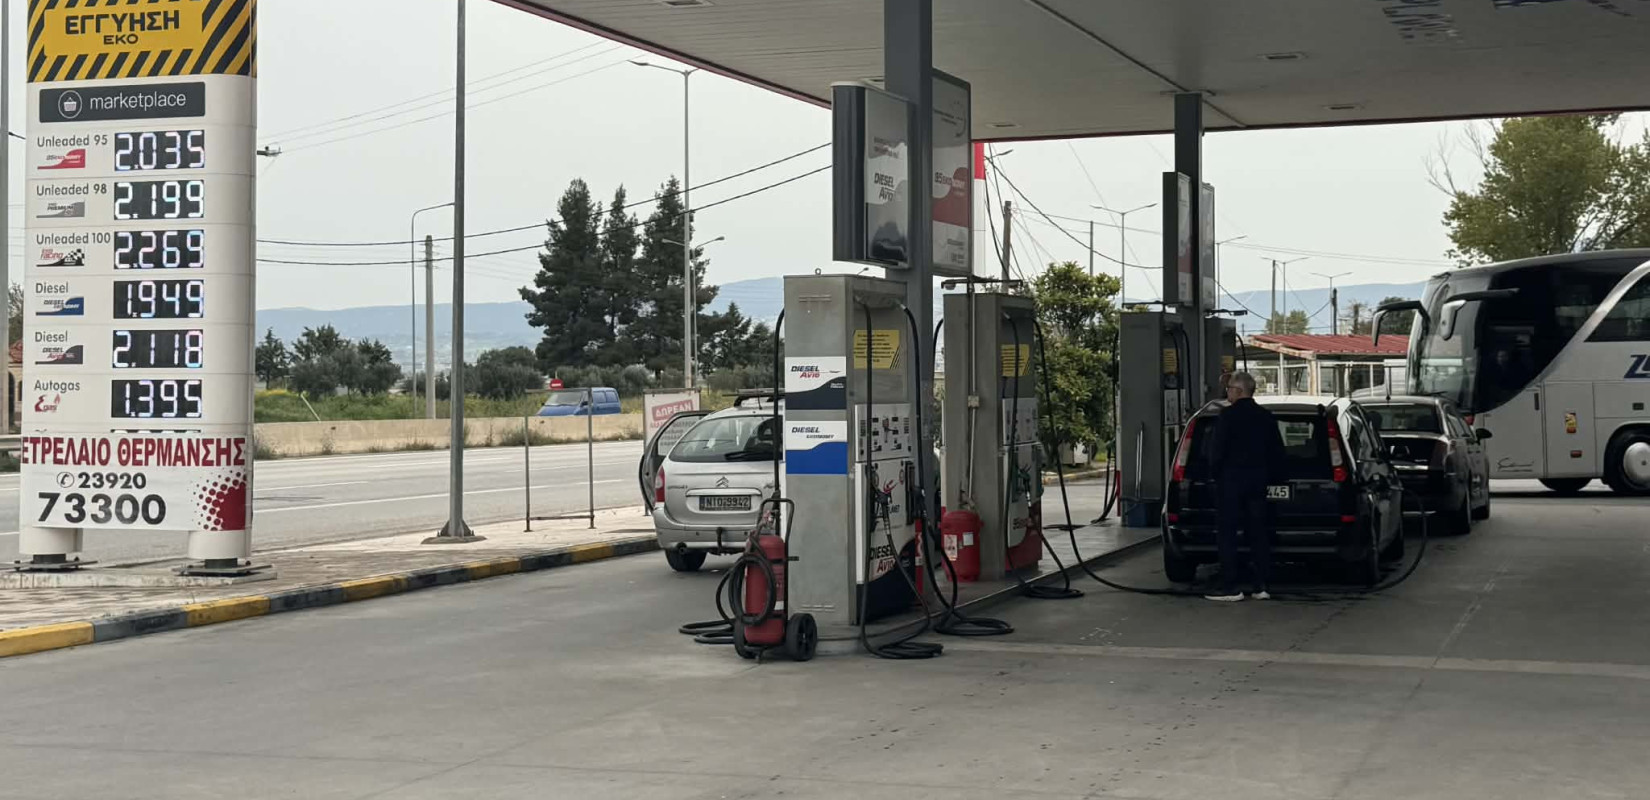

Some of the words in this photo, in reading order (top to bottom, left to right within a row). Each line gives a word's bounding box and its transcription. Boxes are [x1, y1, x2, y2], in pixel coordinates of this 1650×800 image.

[65, 10, 180, 35] ΕΓΓΥΗΣΗ
[90, 91, 187, 111] marketplace
[37, 134, 90, 148] Unleaded
[93, 134, 108, 146] 95
[115, 130, 205, 170] 2.035
[36, 183, 89, 196] Unleaded
[93, 183, 107, 195] 98
[114, 180, 204, 219] 2.199
[36, 232, 90, 246] Unleaded
[92, 232, 111, 244] 100
[114, 230, 204, 269] 2.269
[35, 281, 69, 294] Diesel
[127, 280, 204, 318] 1.949
[34, 330, 68, 342] Diesel
[113, 330, 203, 368] 2.118
[34, 379, 81, 394] Autogas
[125, 379, 202, 418] 1.395
[791, 426, 820, 434] DIESEL
[117, 437, 246, 467] ΘΕΡΜΑΝΣΗΣ
[78, 472, 147, 489] 23920
[38, 491, 167, 526] 73300
